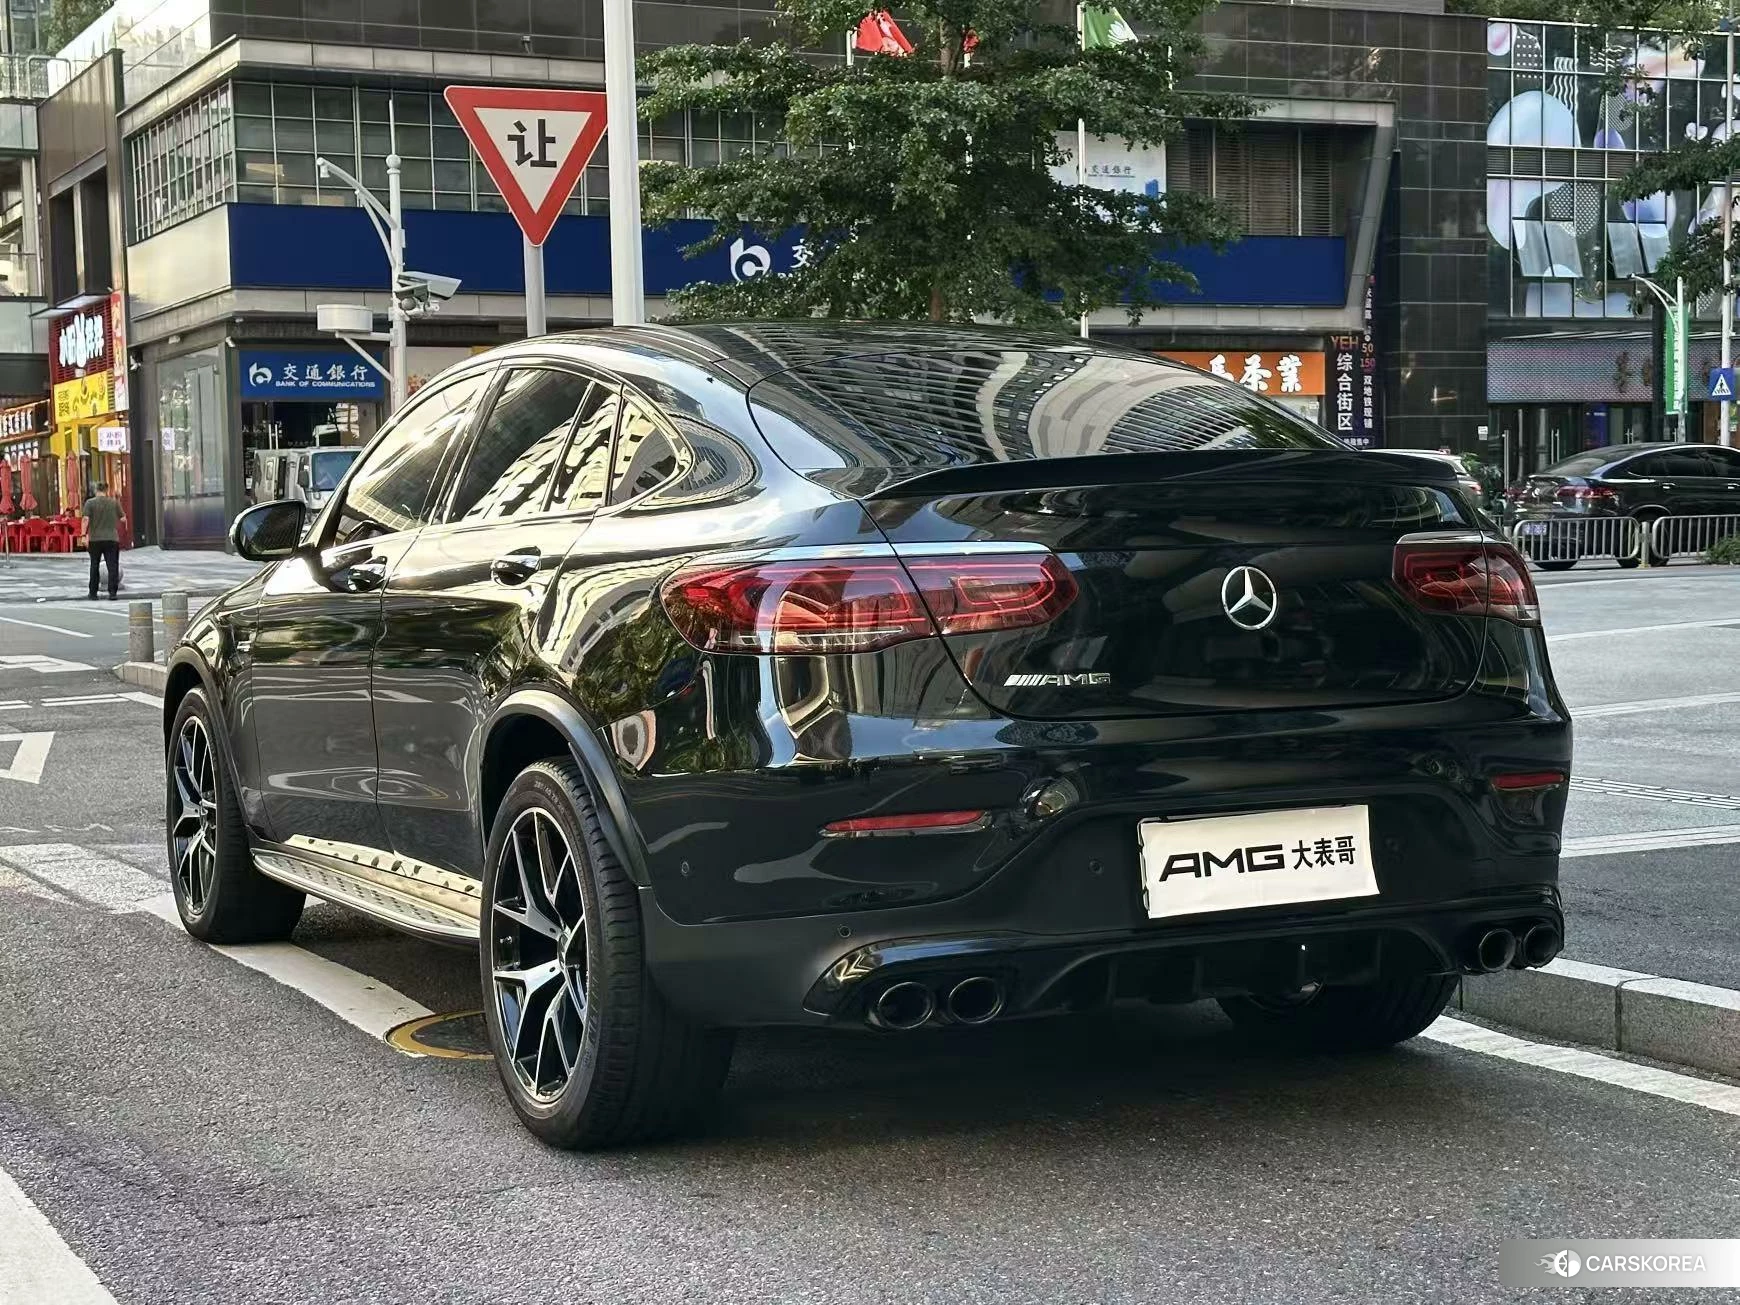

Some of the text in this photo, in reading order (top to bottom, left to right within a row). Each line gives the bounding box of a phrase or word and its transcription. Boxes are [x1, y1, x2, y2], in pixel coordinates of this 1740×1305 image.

[507, 119, 558, 168] 让
[1362, 343, 1373, 352] 50
[1337, 352, 1353, 431] 综合街区
[1038, 672, 1111, 686] AMG
[1159, 836, 1356, 882] AMG 大表哥
